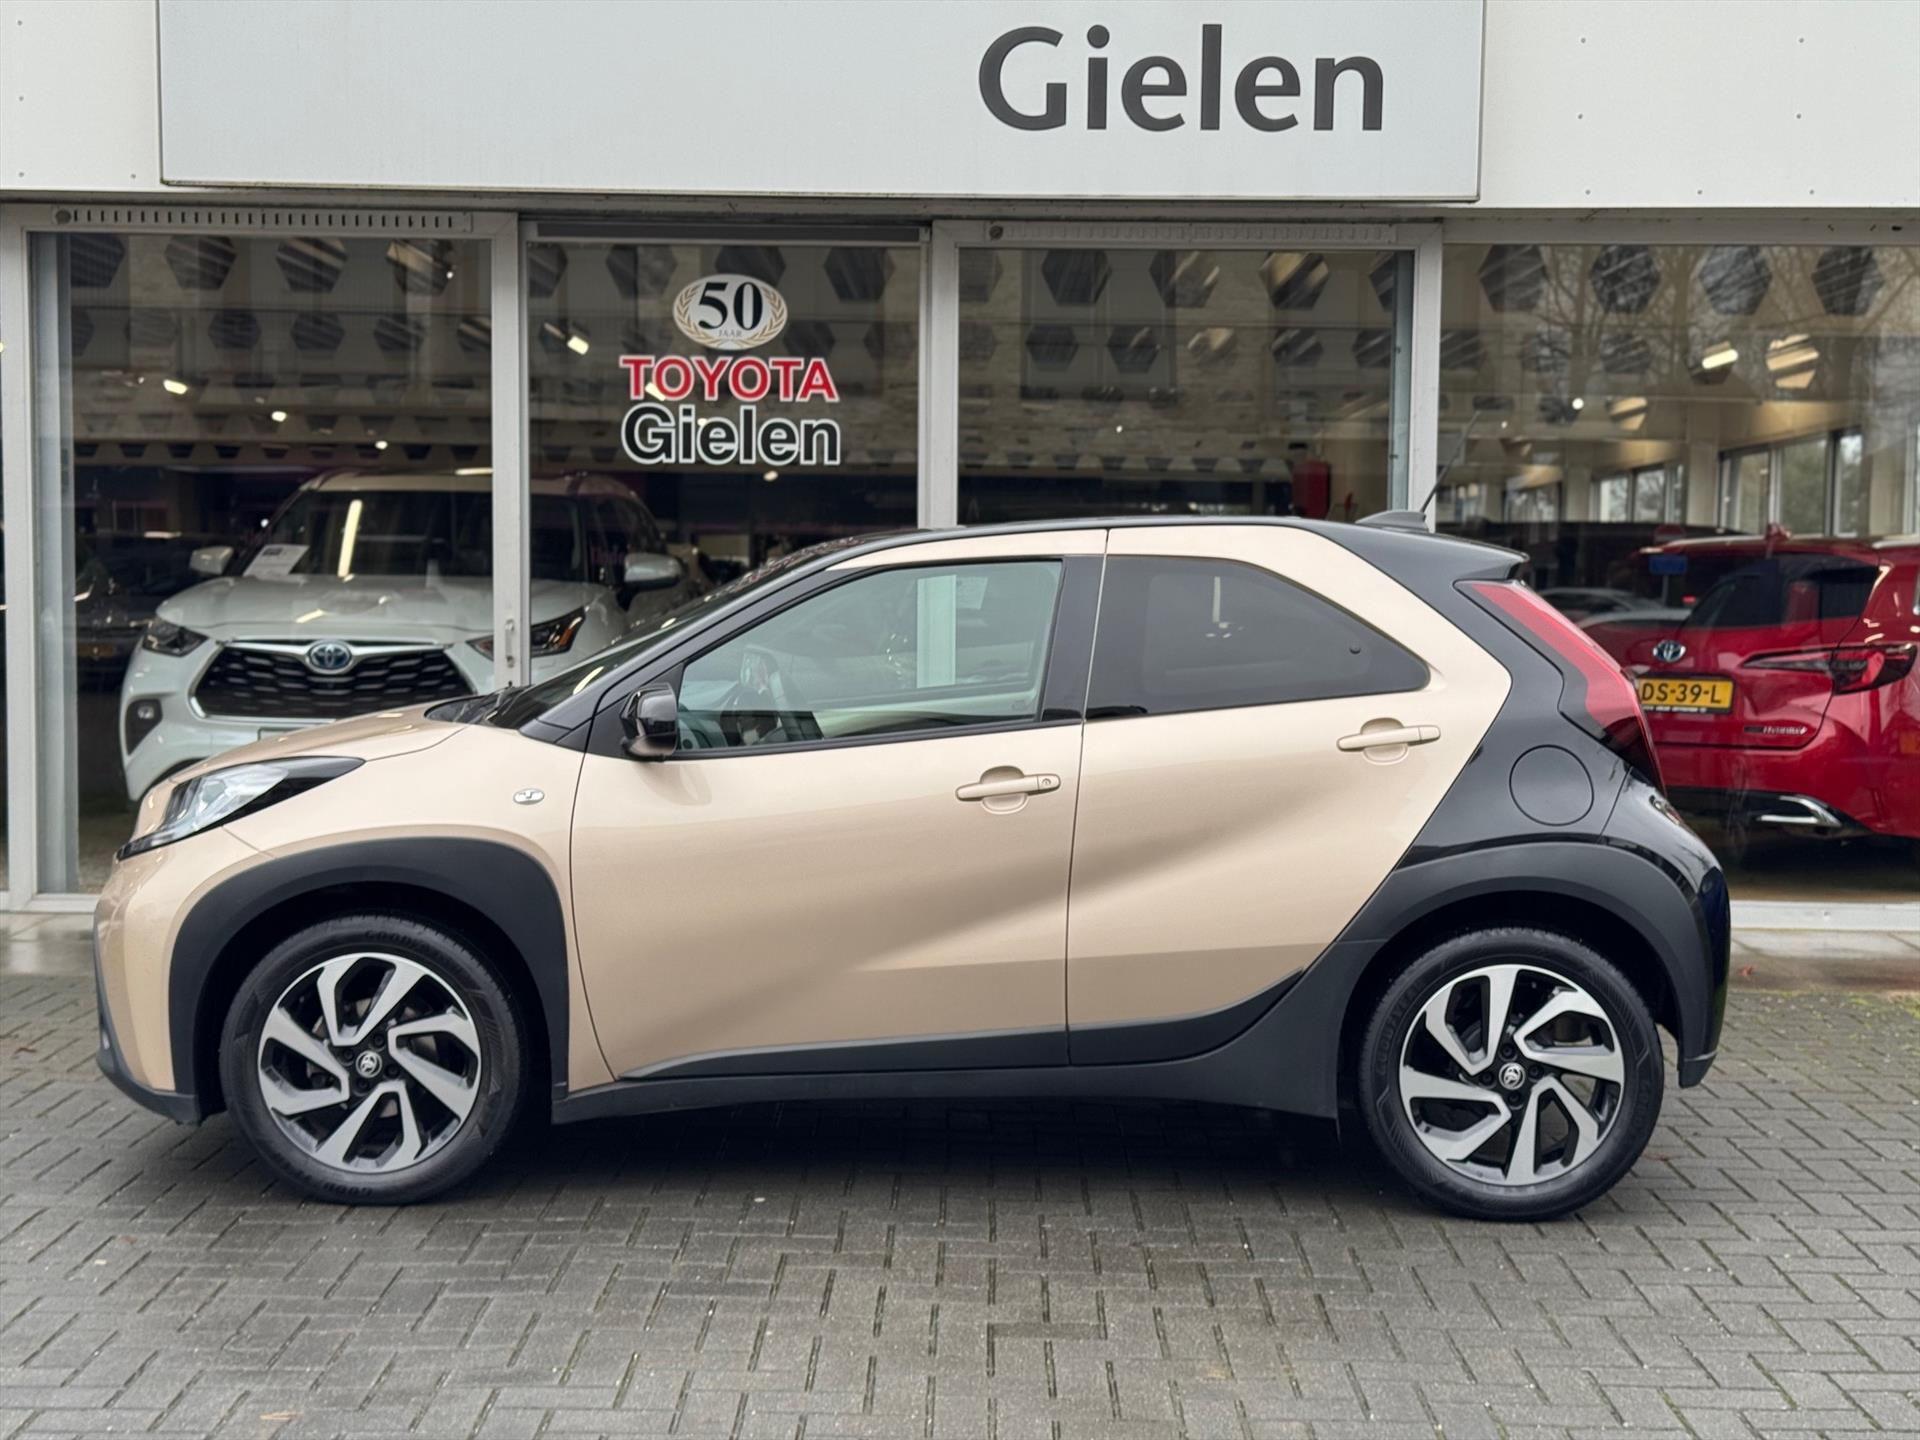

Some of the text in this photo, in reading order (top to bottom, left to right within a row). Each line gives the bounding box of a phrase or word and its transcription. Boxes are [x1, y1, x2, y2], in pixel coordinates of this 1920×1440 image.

[979, 24, 1384, 132] Gielen
[698, 281, 763, 331] 50
[620, 356, 839, 402] TOYOTA
[621, 403, 841, 465] Gielen
